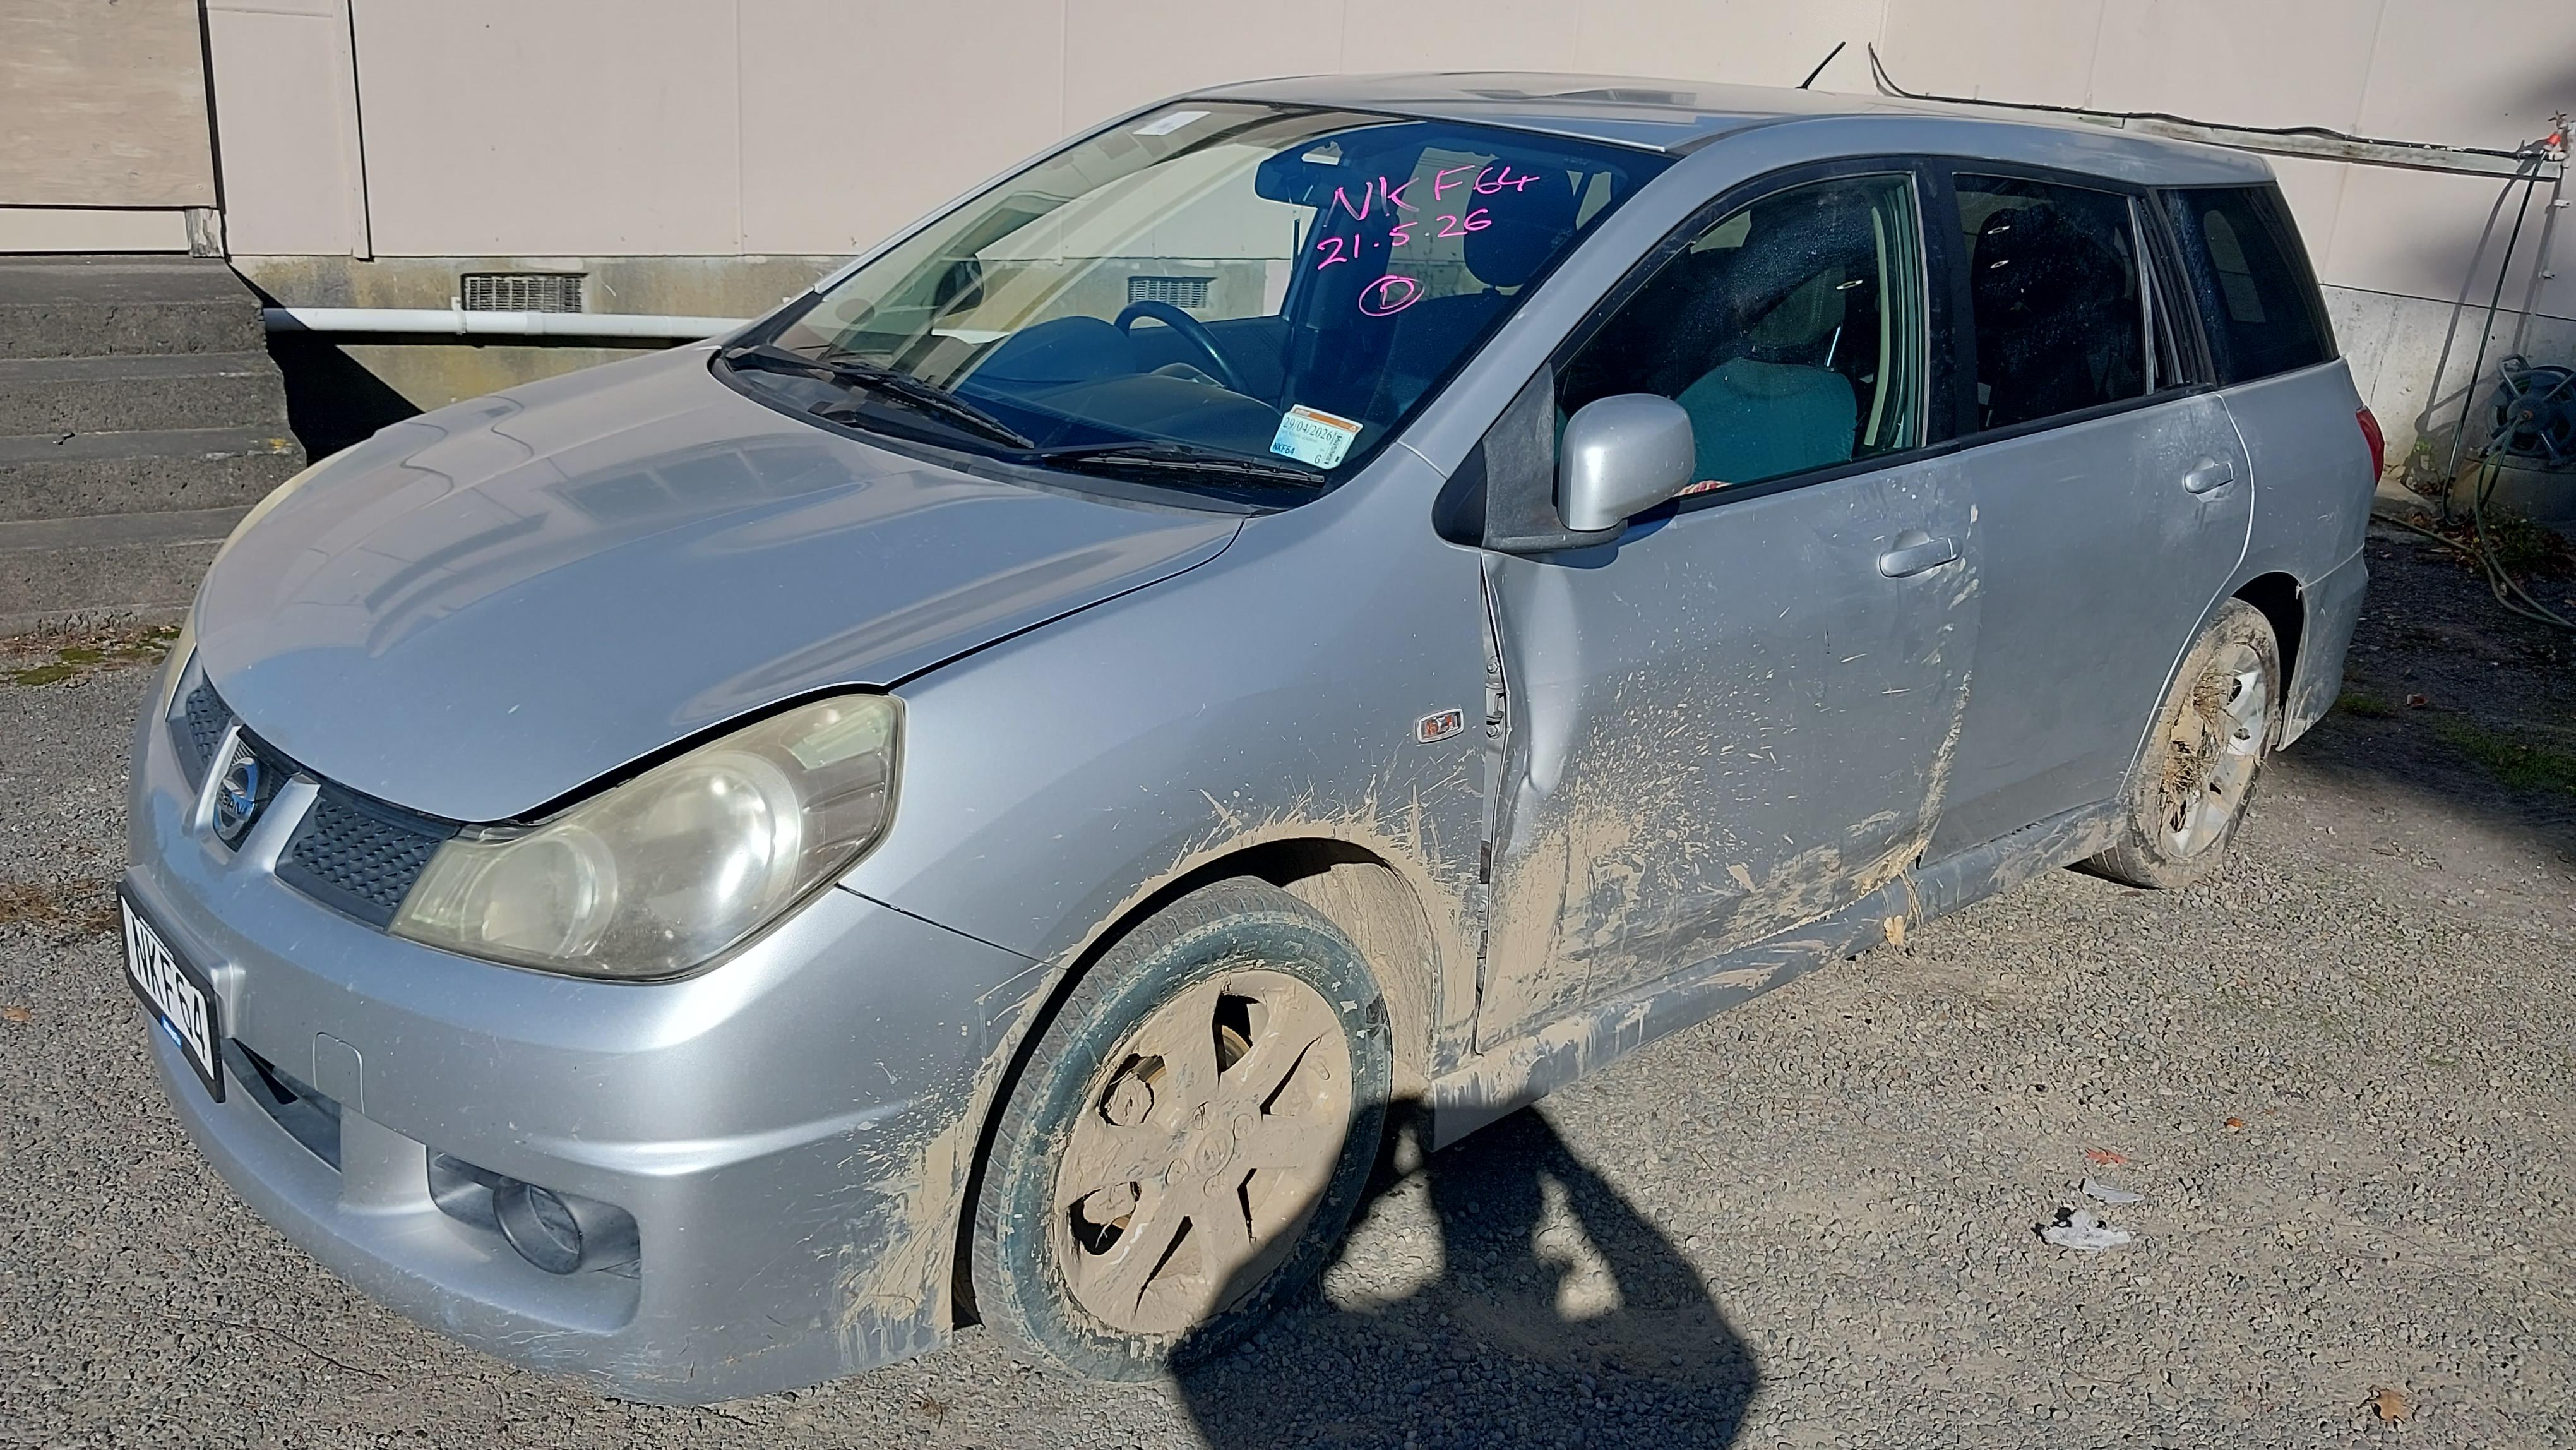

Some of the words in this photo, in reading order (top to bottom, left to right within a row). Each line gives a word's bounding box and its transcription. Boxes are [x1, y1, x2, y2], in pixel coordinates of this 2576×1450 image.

[1282, 417, 1333, 441] 29/04/2026
[1272, 442, 1296, 455] NKF64
[1315, 454, 1322, 464] G
[131, 915, 206, 1062] NKF64
